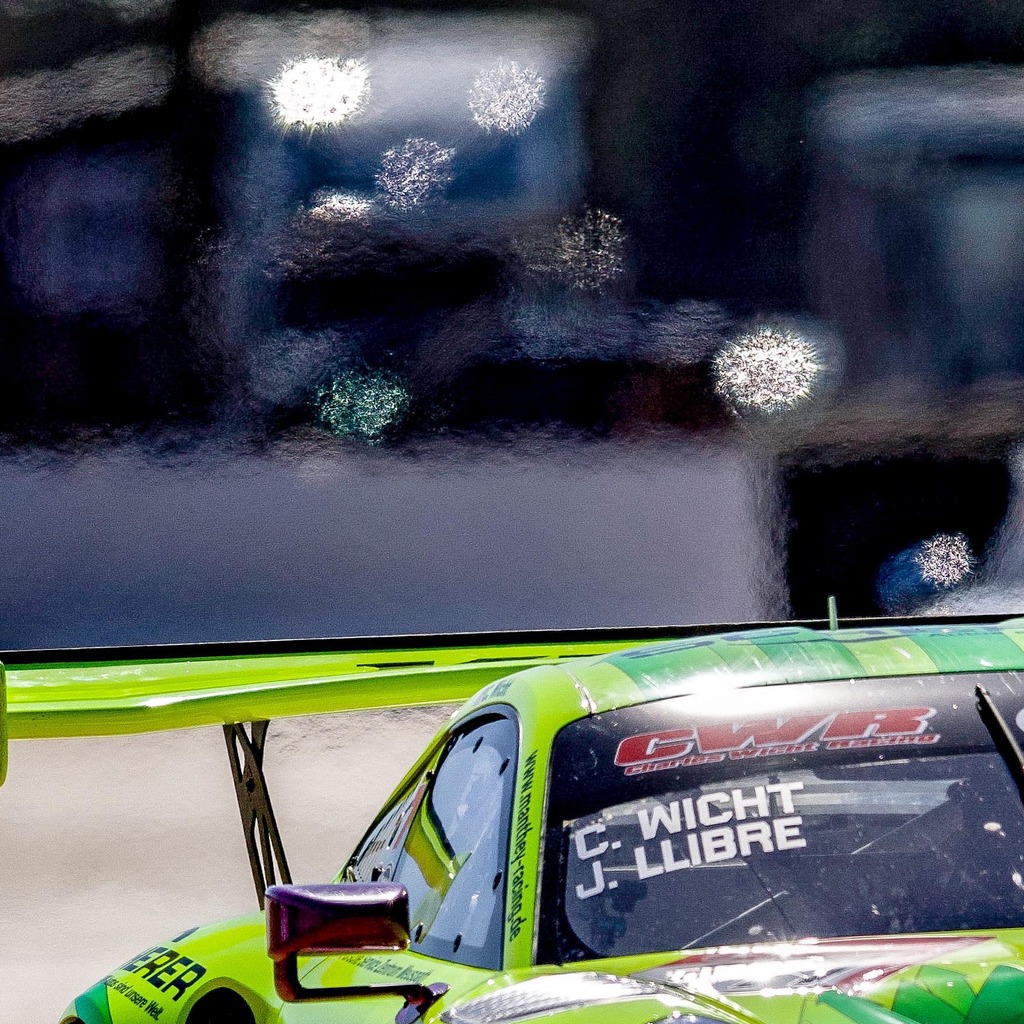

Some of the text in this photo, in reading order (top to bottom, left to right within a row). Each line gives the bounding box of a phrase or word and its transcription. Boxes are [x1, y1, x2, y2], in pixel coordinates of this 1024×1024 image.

[614, 707, 937, 767] CWR
[507, 750, 538, 943] www.manthey-racing.de
[575, 782, 804, 861] C. WICHT
[576, 816, 807, 900] J. LLIBRE
